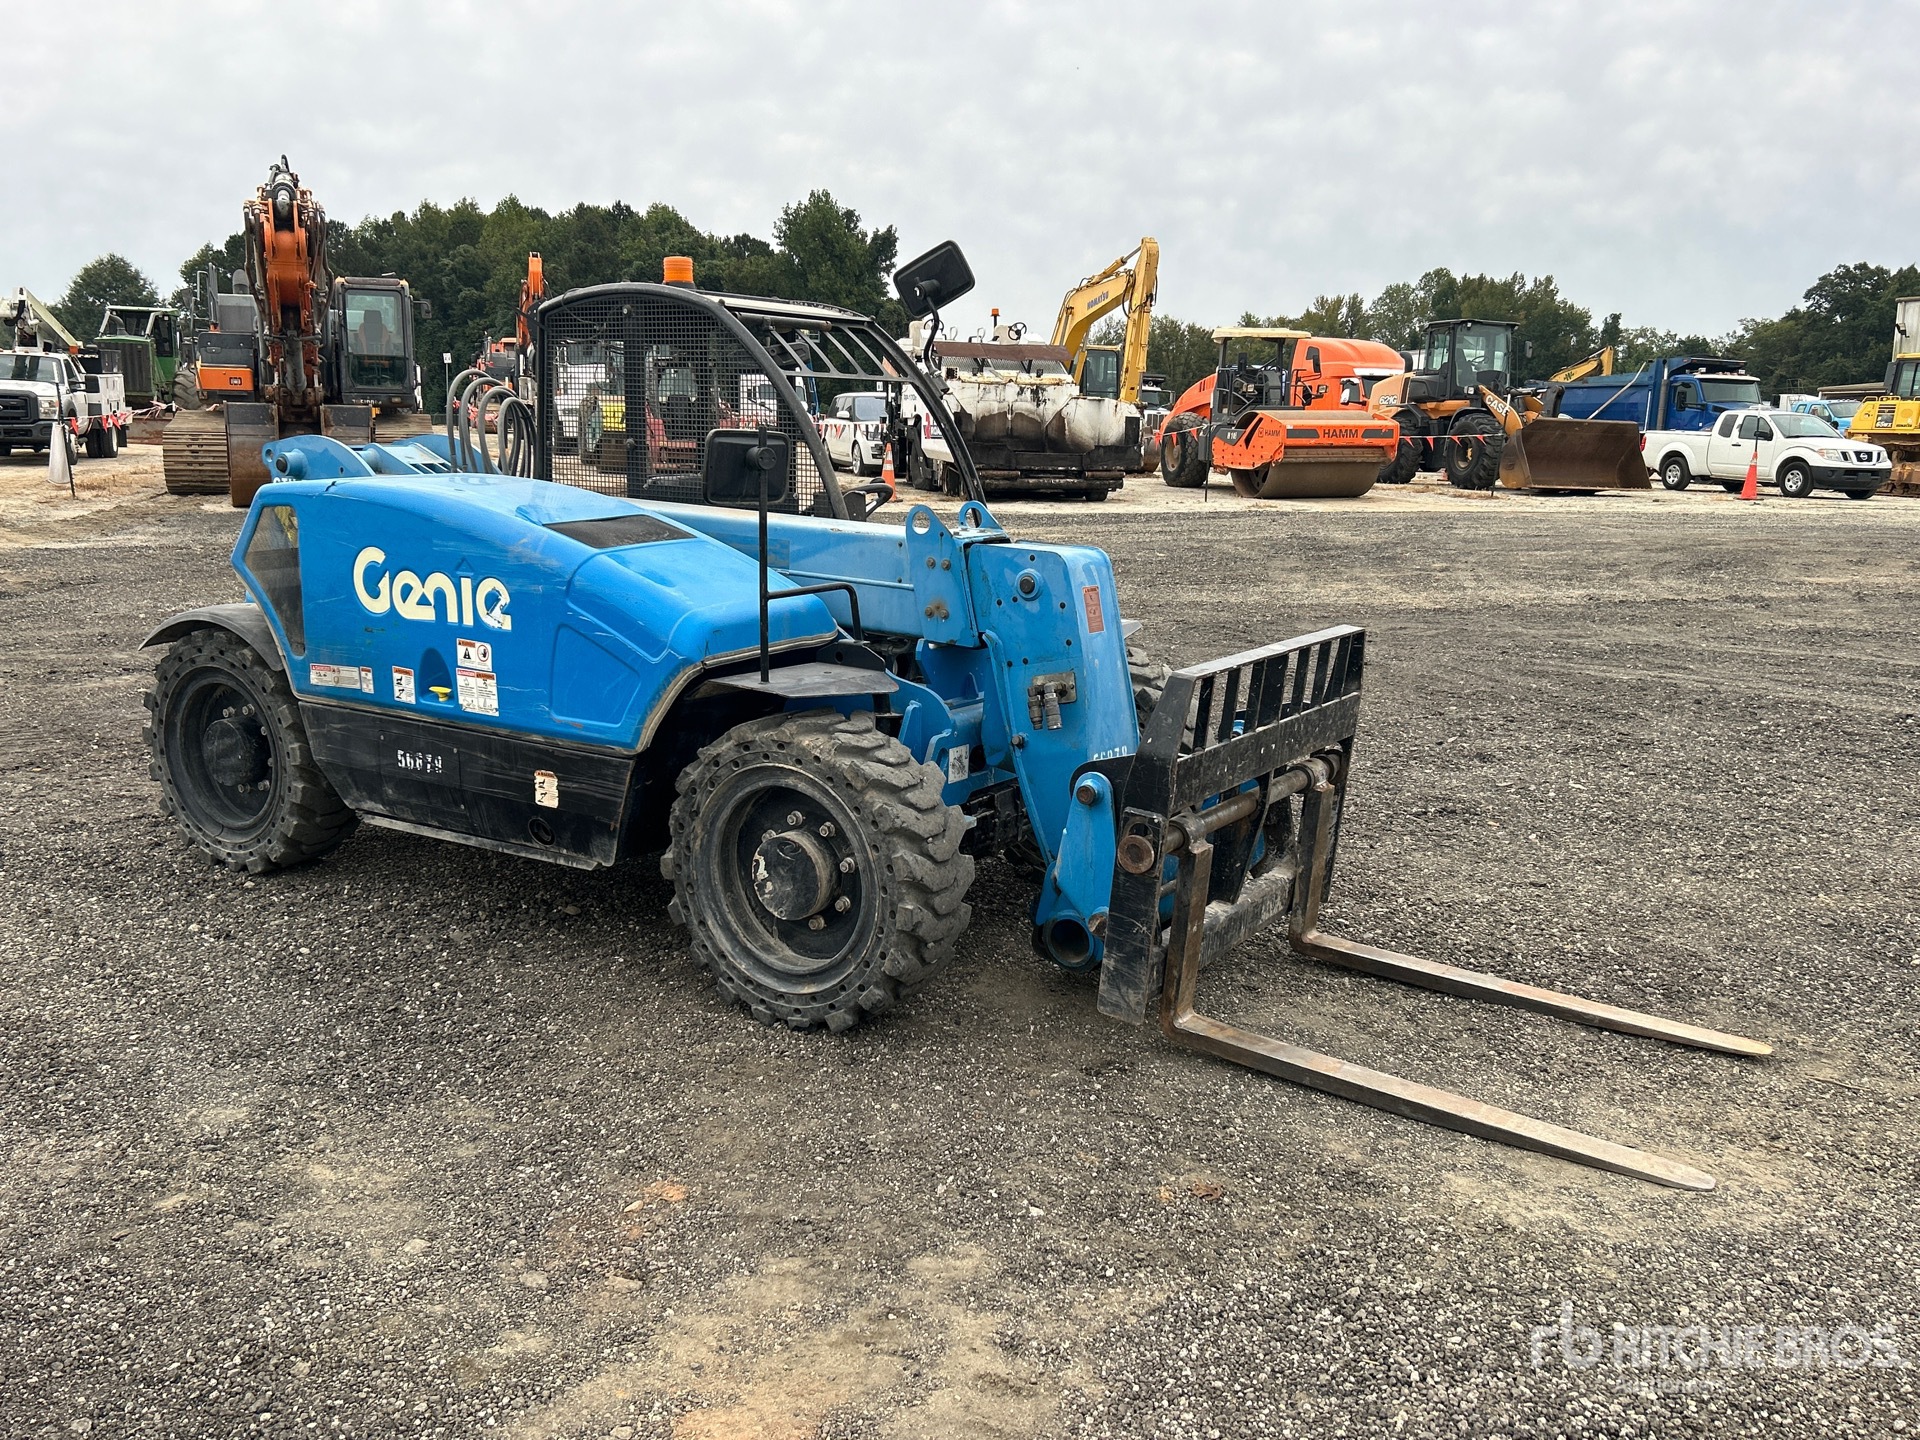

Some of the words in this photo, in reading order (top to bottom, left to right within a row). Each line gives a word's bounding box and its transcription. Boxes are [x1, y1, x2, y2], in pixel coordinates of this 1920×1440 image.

[1485, 394, 1512, 417] CASE
[1322, 428, 1359, 439] HAMM
[353, 546, 512, 631] Genie
